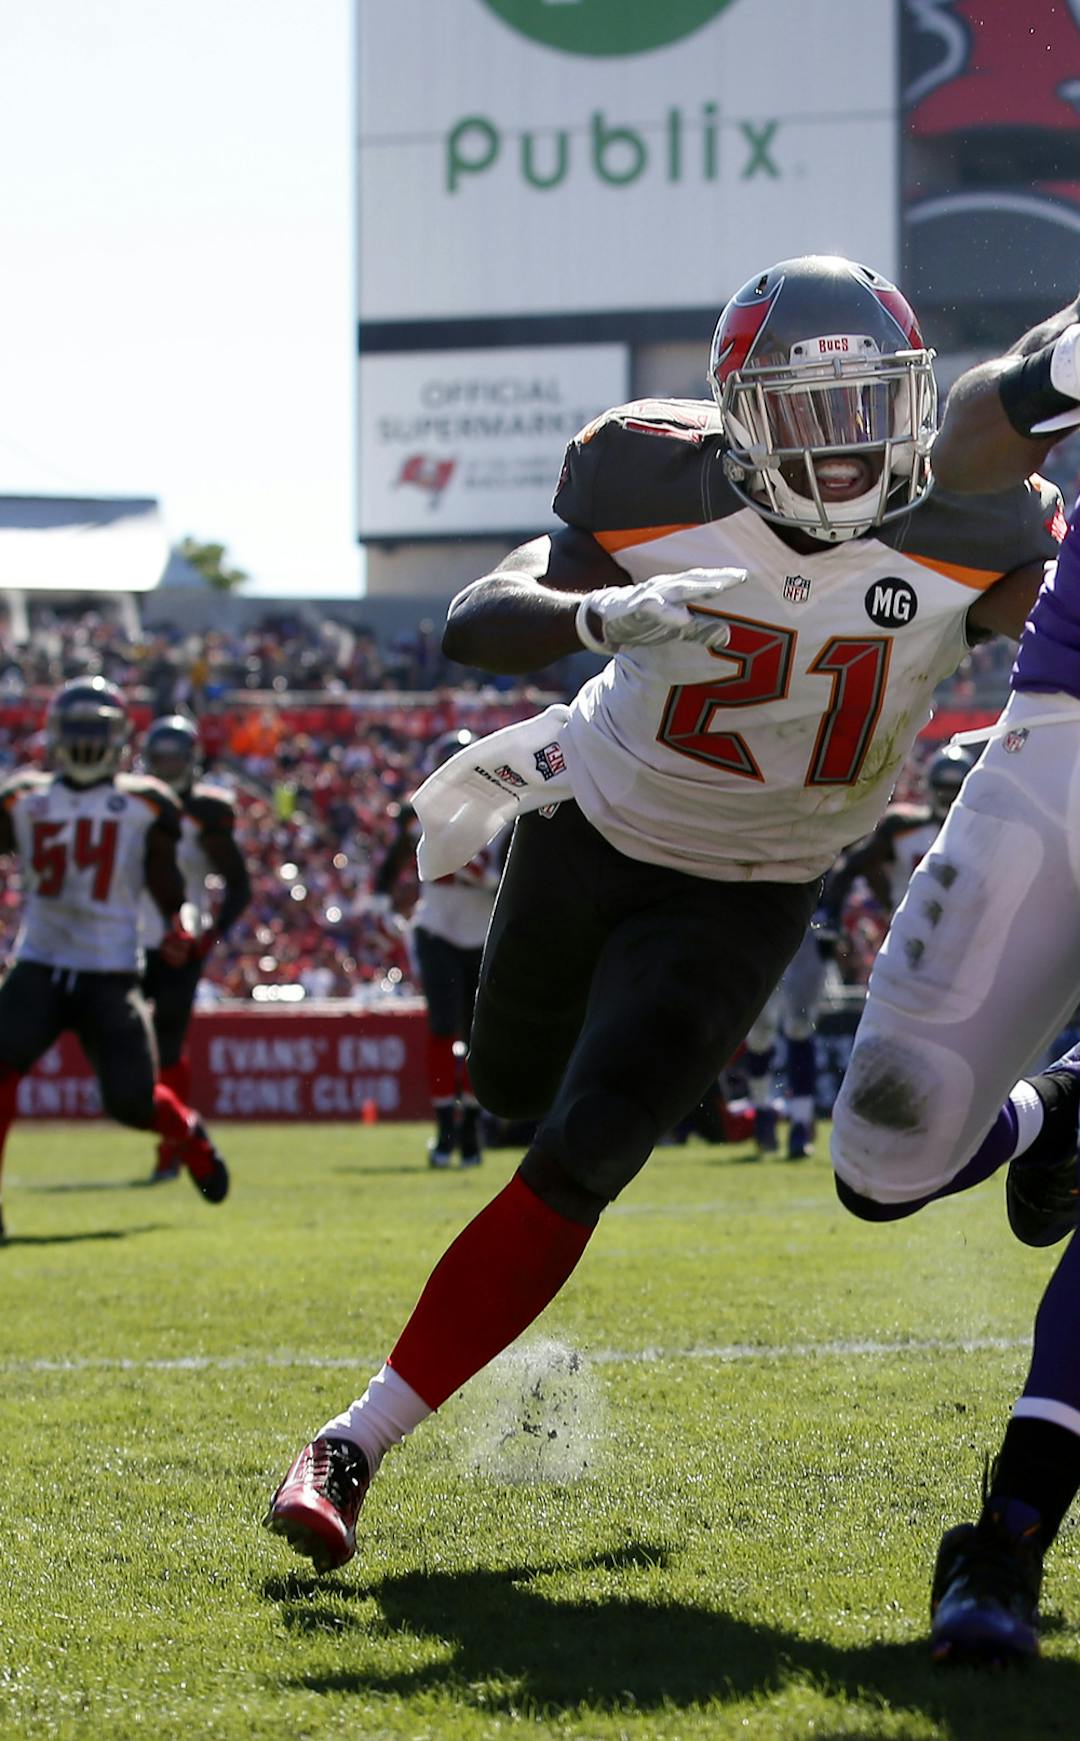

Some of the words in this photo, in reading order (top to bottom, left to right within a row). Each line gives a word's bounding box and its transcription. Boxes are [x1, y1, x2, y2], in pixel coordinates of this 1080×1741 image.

[445, 101, 782, 194] Publix
[420, 375, 562, 409] OFFICIAL
[871, 585, 913, 620] MG
[656, 604, 894, 788] 21
[31, 817, 119, 903] 54
[338, 1035, 407, 1073] END
[216, 1075, 301, 1115] ZONE
[312, 1074, 400, 1114] CLUB
